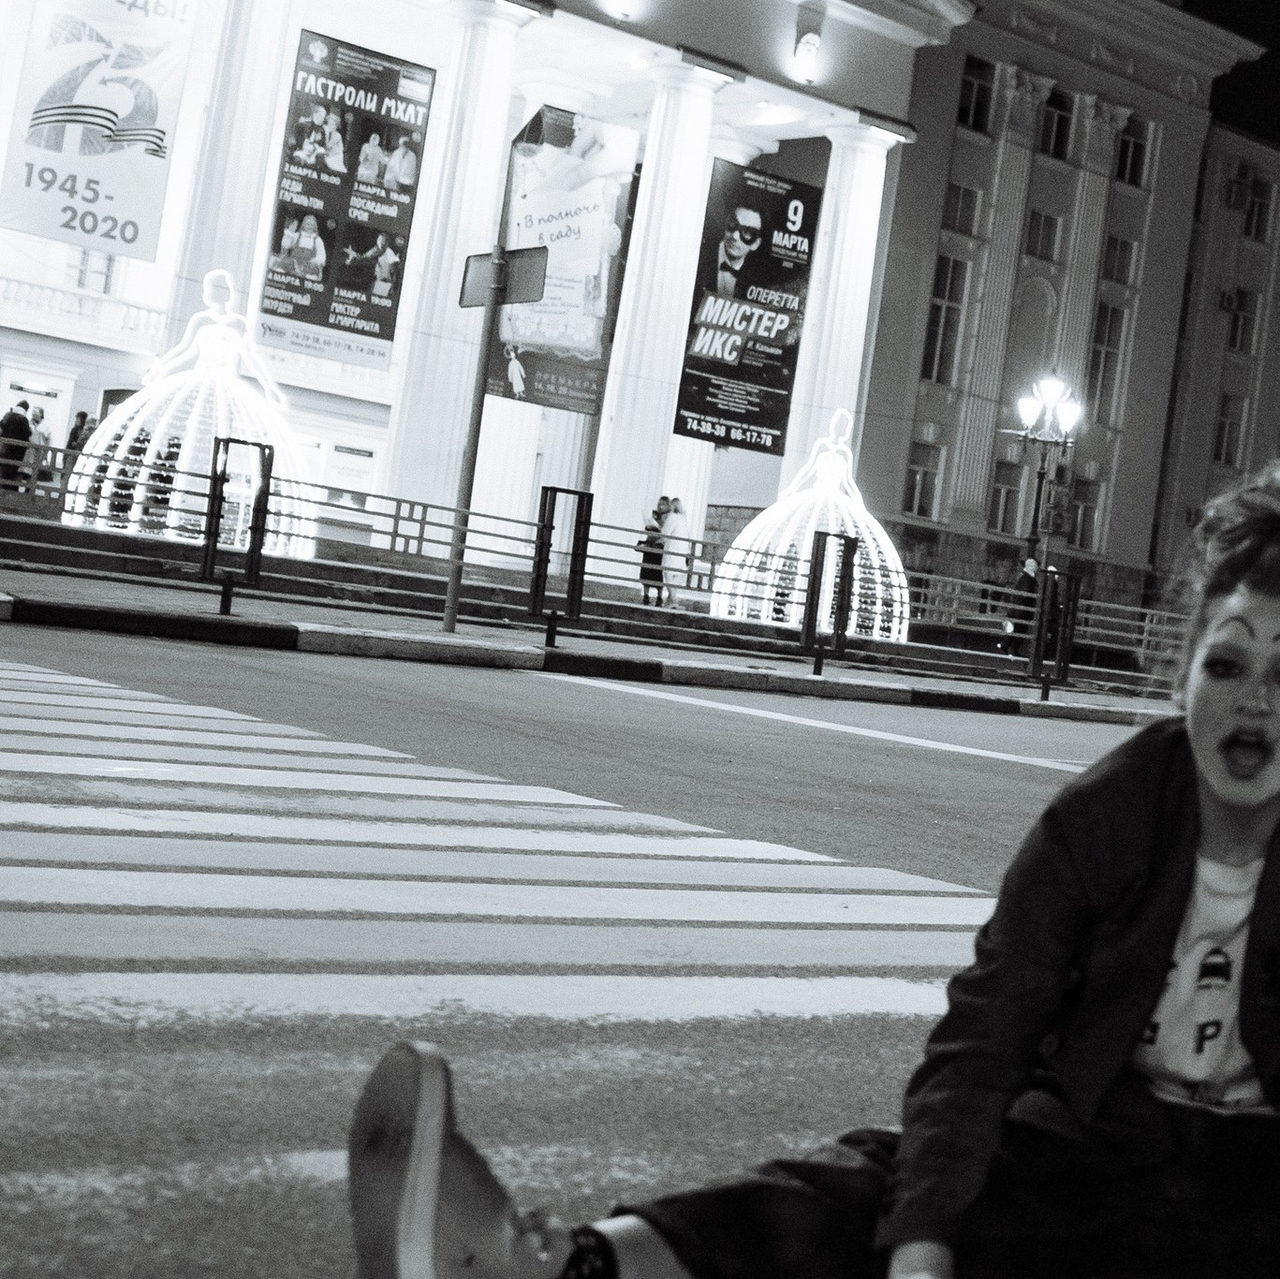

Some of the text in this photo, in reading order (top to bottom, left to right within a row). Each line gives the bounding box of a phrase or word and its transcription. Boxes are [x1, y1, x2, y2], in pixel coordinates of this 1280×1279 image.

[296, 70, 378, 113] ГАСТРОЛИ
[381, 96, 427, 126] МХАТ
[25, 162, 114, 204] 1945-
[290, 164, 318, 179] МАРТА
[358, 183, 386, 198] МАРТА
[60, 206, 139, 244] 2020
[524, 202, 600, 229] В полночь
[786, 199, 804, 232] 9
[538, 225, 581, 245] в саду
[772, 230, 809, 253] МАРТА
[273, 273, 300, 286] МАРТА
[339, 288, 367, 302] МАРТА
[746, 285, 799, 310] ОПЕРЕТТА
[700, 296, 790, 339] МИСТЕР
[694, 326, 742, 361] ИКС
[730, 428, 772, 447] 66-17-78
